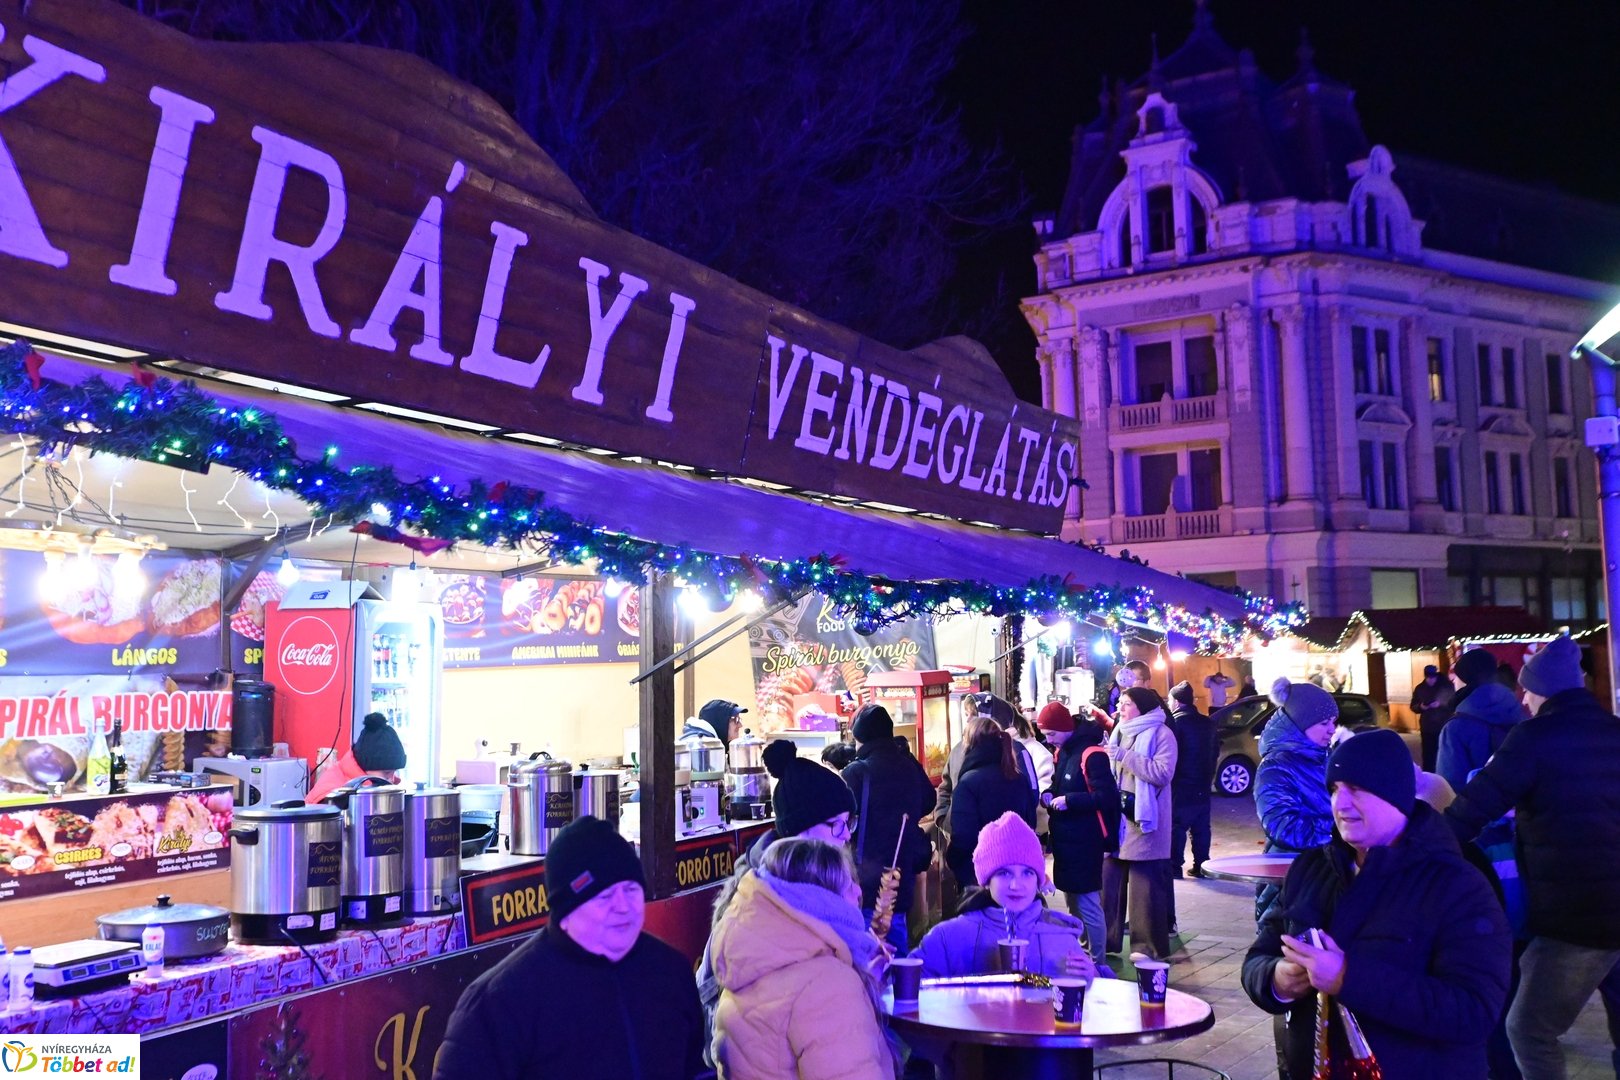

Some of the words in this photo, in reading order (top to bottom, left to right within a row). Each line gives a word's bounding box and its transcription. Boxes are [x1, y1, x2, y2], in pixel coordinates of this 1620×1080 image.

[765, 334, 1077, 508] VENDÉGLÁTÁS
[112, 645, 177, 666] LÁNGOS
[281, 643, 336, 667] Coca-Cola
[763, 647, 824, 675] Spirál
[828, 640, 919, 668] burgonya
[93, 691, 233, 732] BURGONYA
[54, 846, 103, 865] CSIRKÉS
[675, 848, 711, 886] ORRÓ
[713, 851, 733, 877] TEA
[492, 884, 549, 925] FORRA
